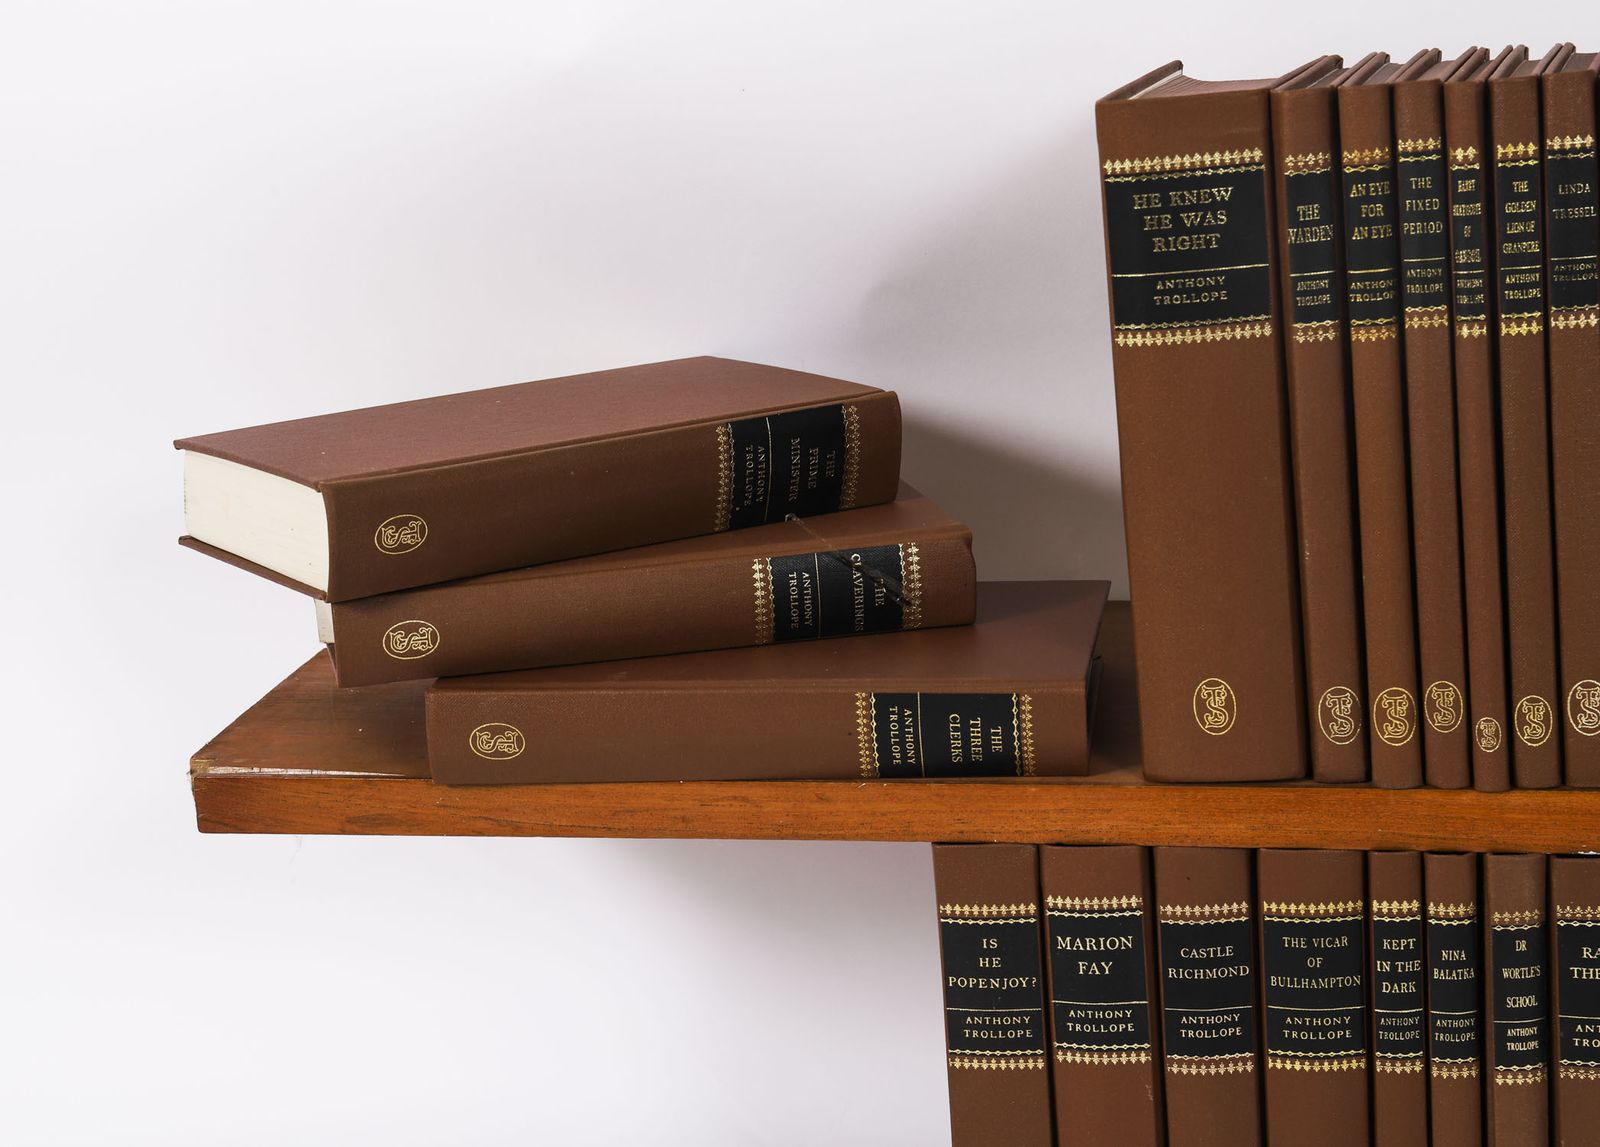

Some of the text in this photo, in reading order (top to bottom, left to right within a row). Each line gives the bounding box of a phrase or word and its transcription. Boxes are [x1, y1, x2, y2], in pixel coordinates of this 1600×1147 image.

[1350, 182, 1390, 197] AN EYE
[1410, 177, 1432, 190] THE
[1512, 181, 1528, 192] THE
[1559, 183, 1591, 194] LINDA
[1133, 187, 1234, 209] HE KNEW
[1361, 204, 1384, 217] FOR
[1405, 199, 1440, 211] FIXED
[1505, 200, 1536, 213] GOLDEN
[1297, 204, 1320, 221] THE
[1552, 206, 1597, 219] TRESSEL
[1144, 210, 1227, 231] HE WAS
[1352, 225, 1392, 240] AN EYE
[1403, 221, 1443, 235] PERIOD
[1506, 221, 1535, 234] LION OF
[1152, 233, 1221, 252] RIGHT
[1503, 241, 1540, 254] GRANPERE
[1406, 268, 1442, 278] ANTHONY
[1554, 263, 1598, 271] ANTHONY
[1156, 276, 1225, 290] ANTHONY
[1505, 273, 1540, 284] ANTHONY
[1297, 280, 1329, 291] ANTHONY
[1406, 283, 1444, 293] TROLLOPE
[1153, 291, 1228, 305] TROLLOPE
[1296, 294, 1331, 306] TROLLOPE
[1505, 288, 1541, 299] TROLLOPE
[788, 437, 801, 501] MINISTER
[808, 448, 819, 489] PRIME
[826, 450, 836, 478] THE
[744, 444, 754, 506] TROLLOPE
[756, 446, 766, 502] ANTHONY
[788, 571, 799, 629] TROLLOPE
[802, 572, 813, 626] ANTHONY
[889, 706, 901, 765] TROLLOPE
[904, 708, 916, 764] ANTHONY
[949, 713, 963, 763] CLERKS
[969, 717, 982, 762] THREE
[991, 726, 1003, 752] THE
[982, 938, 998, 949] IS
[1056, 936, 1133, 950] MARION
[1282, 936, 1349, 948] THE VICAR
[1383, 938, 1417, 950] KEPT
[1515, 940, 1527, 952] DR
[1180, 945, 1234, 959] CASTLE
[1442, 950, 1467, 961] NINA
[979, 957, 1001, 968] HE
[1078, 962, 1113, 975] FAY
[1307, 958, 1323, 968] OF
[1376, 960, 1421, 972] IN THE
[1168, 965, 1250, 979] RICHMOND
[1433, 968, 1475, 980] BALATKA
[1502, 965, 1541, 980] WORTLE'S
[949, 976, 1037, 990] POPENJOY?
[1270, 975, 1361, 989] BULLHAMPTON
[1382, 981, 1416, 993] DARK
[1506, 995, 1538, 1008] SCHOOL
[966, 1016, 1031, 1025] ANTHONY
[1069, 1009, 1133, 1019] ANTHONY
[1181, 1013, 1240, 1025] ANTHONY
[1067, 1022, 1135, 1033] TROLLOPE
[1285, 1016, 1351, 1026] ANTHONY
[1380, 1016, 1420, 1026] ANTHONY
[1436, 1018, 1476, 1028] ANTHONY
[964, 1029, 1033, 1039] TROLLOPE
[1180, 1027, 1242, 1039] TROLLOPE
[1283, 1029, 1352, 1040] TROLLOPE
[1379, 1030, 1420, 1040] TROLLOPE
[1434, 1032, 1476, 1042] TROLLOPE
[1507, 1026, 1538, 1037] ANTHONY
[1507, 1041, 1539, 1051] TROLLOPE
